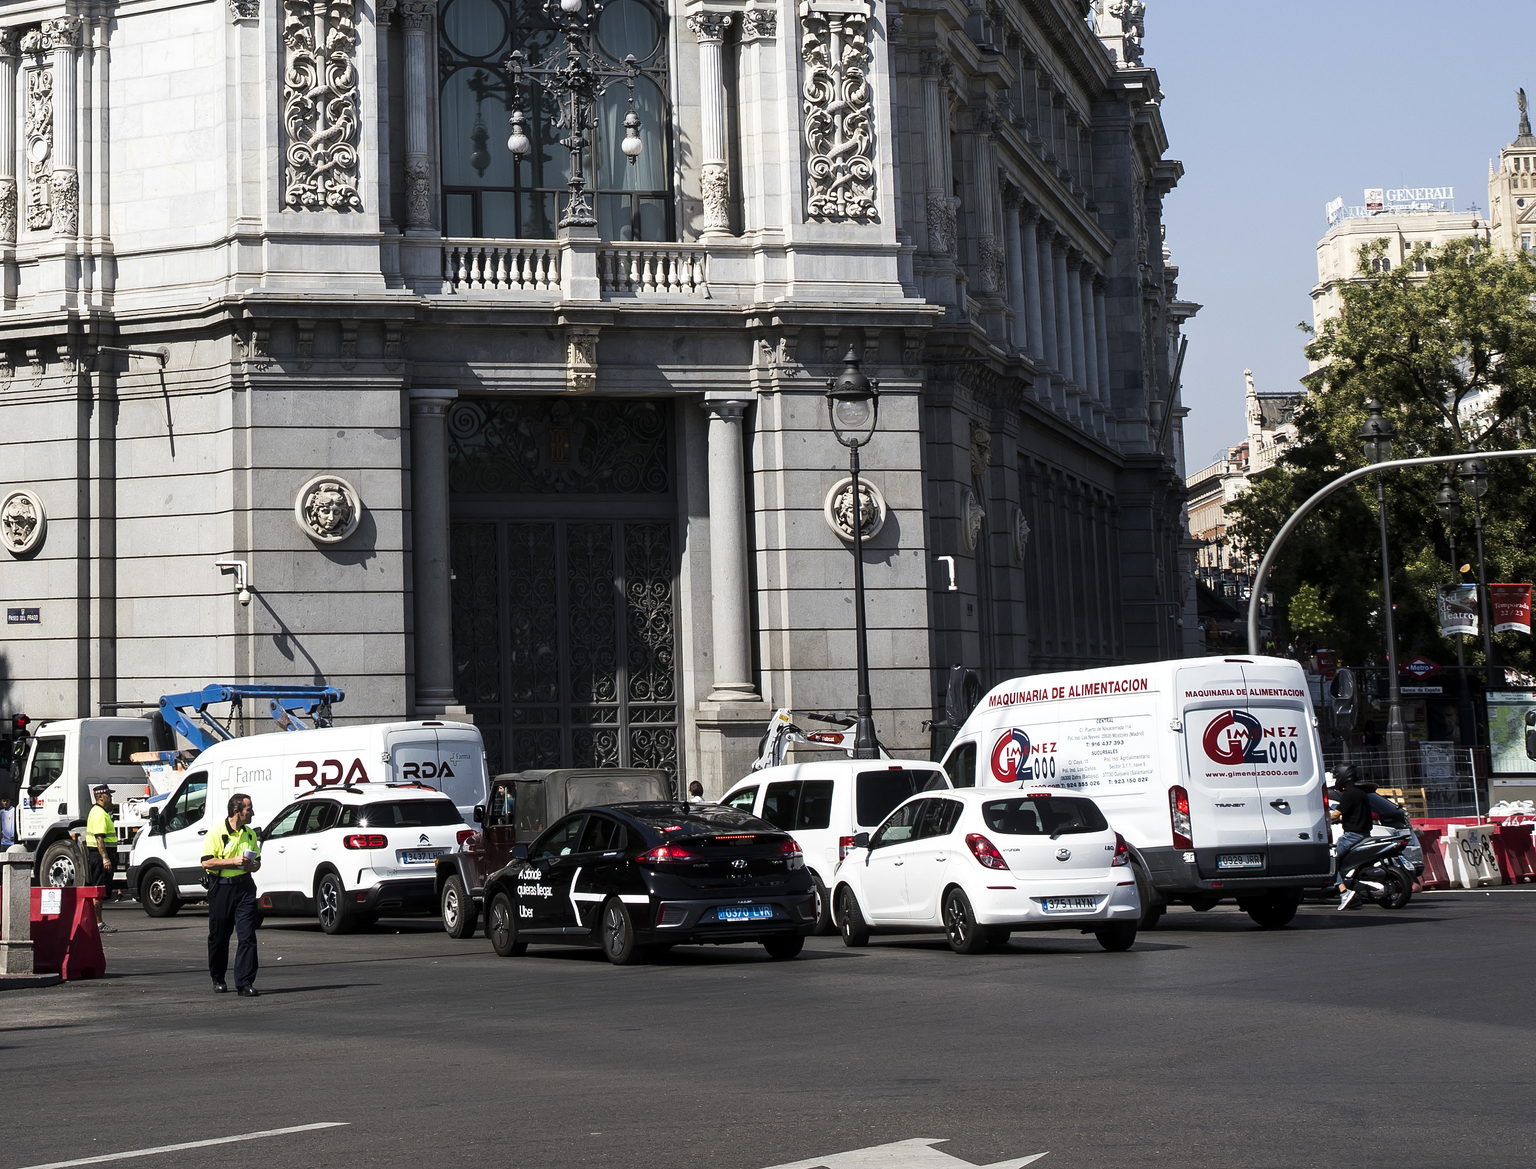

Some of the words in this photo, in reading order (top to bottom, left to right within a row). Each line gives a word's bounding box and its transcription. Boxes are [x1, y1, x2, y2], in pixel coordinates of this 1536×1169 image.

[1386, 187, 1454, 201] GENERALI
[1439, 593, 1457, 602] Sed
[1440, 603, 1452, 612] de
[1442, 612, 1474, 620] Teatro
[989, 688, 1048, 707] MAQUINARIA
[1052, 686, 1064, 699] DE
[1068, 678, 1148, 697] ALIMENTACION
[1185, 689, 1234, 697] MAQUINARIA
[1249, 689, 1304, 697] ALIMENTACION
[236, 766, 272, 783] Farma
[294, 757, 371, 787] RDA
[403, 761, 455, 780] RDA
[1205, 770, 1299, 778] www.gimenez2000.com
[408, 853, 426, 861] 3437
[1222, 855, 1243, 865] 0929
[1245, 854, 1260, 864] JRR
[518, 869, 524, 880] A
[524, 868, 542, 880] donde
[517, 883, 537, 898] quieras
[536, 883, 553, 899] llegar.
[1049, 899, 1073, 909] 3751
[1075, 897, 1094, 908] HYN
[519, 905, 534, 918] Uber
[725, 907, 749, 918] 0370
[753, 906, 771, 917] LVR
